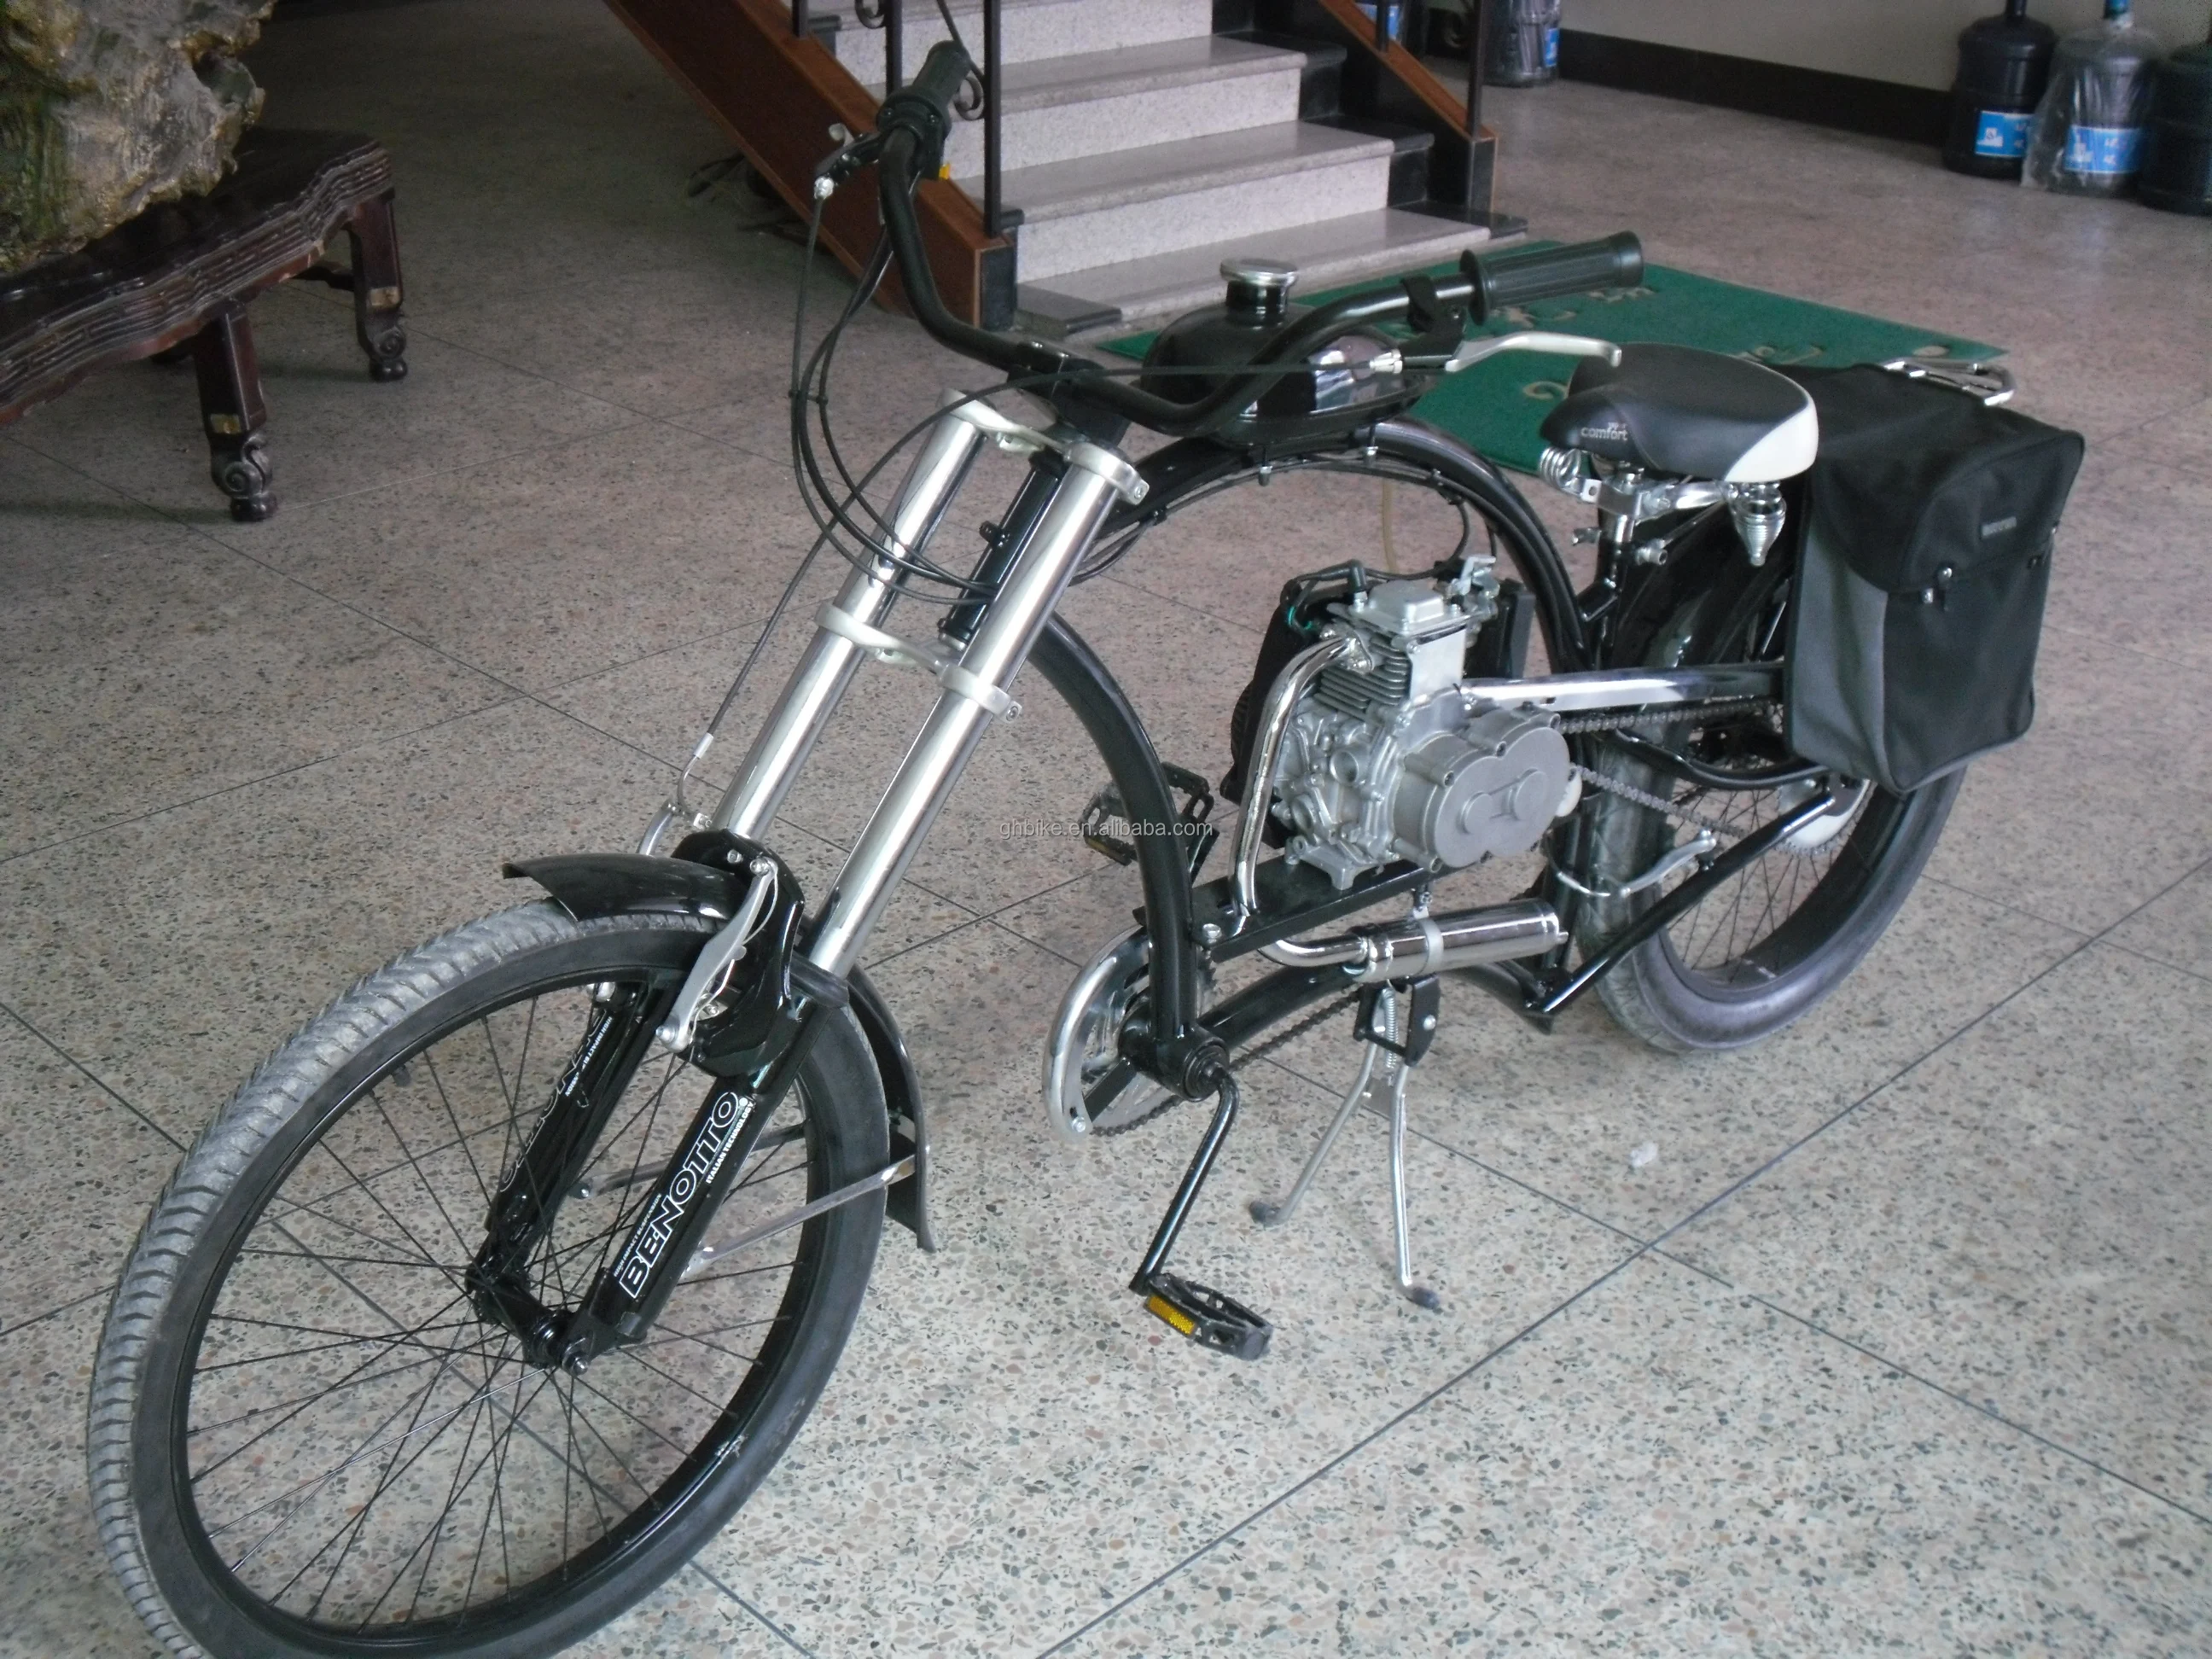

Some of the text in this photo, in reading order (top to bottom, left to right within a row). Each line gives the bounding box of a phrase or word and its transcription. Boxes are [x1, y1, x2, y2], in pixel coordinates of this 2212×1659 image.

[1580, 426, 1628, 441] comfort
[587, 1032, 604, 1057] IMPACT
[601, 1016, 613, 1033] HIGH
[706, 1101, 754, 1185] ITALIAN TECHNOLOGY
[619, 1091, 739, 1299] BENOTTO
[614, 1193, 661, 1277] HIGH IMPACT SUSPENSION
